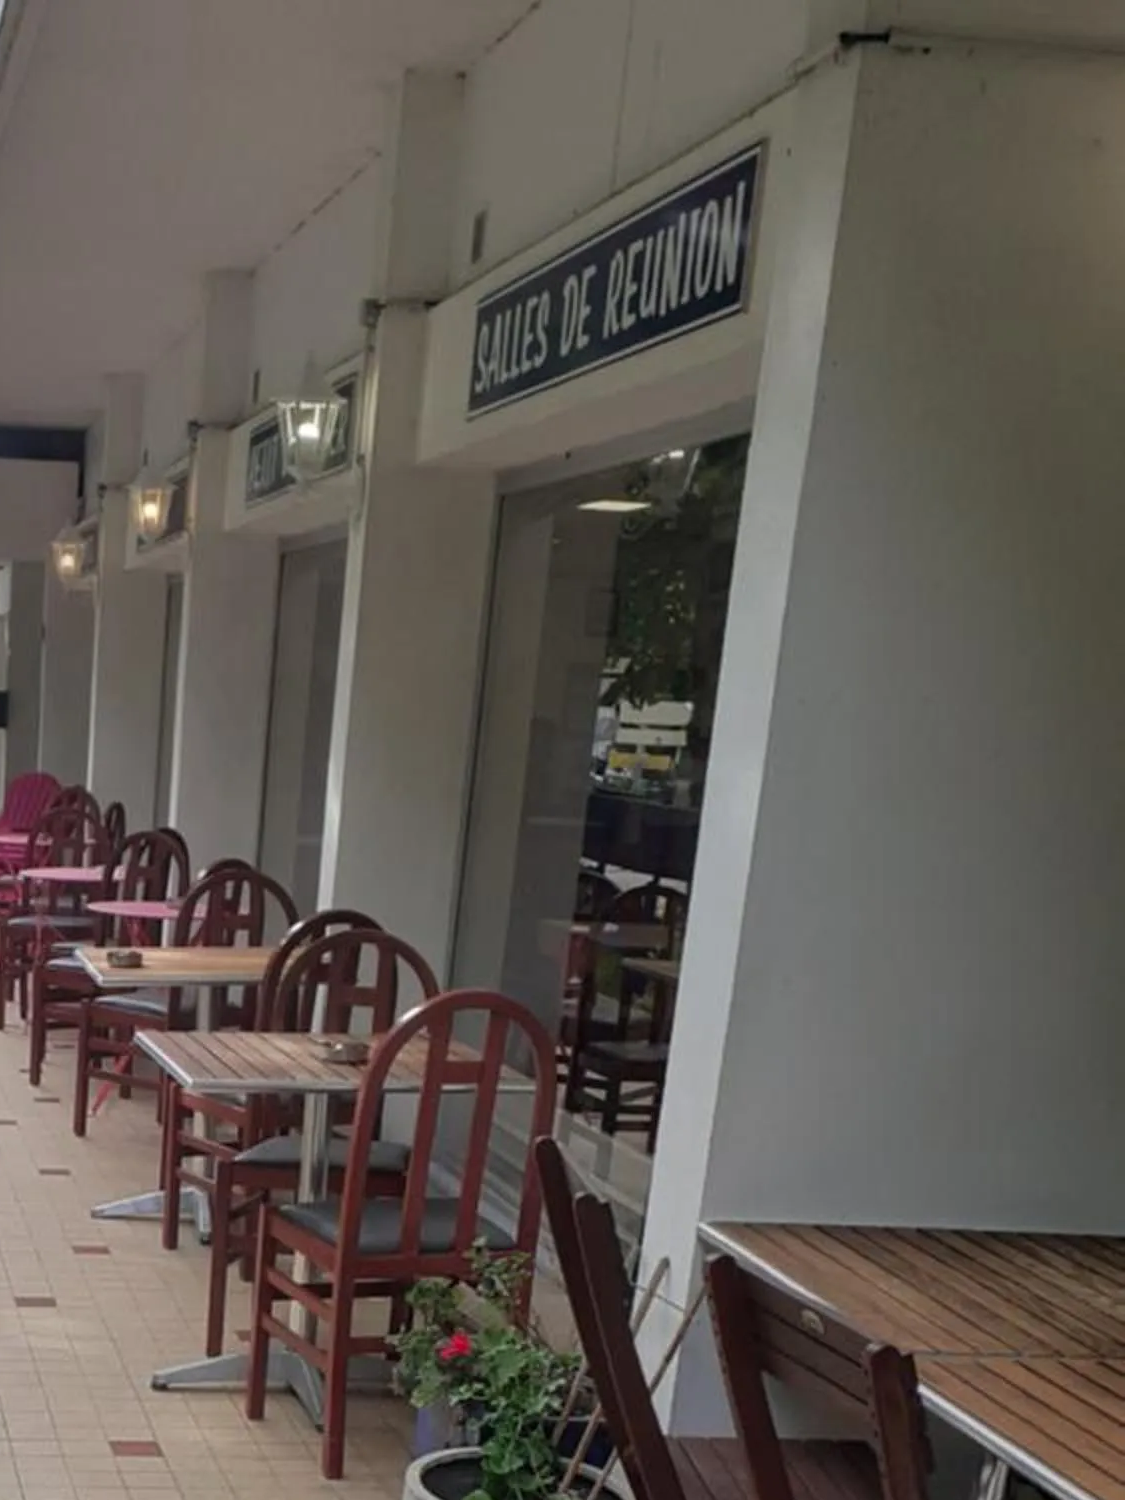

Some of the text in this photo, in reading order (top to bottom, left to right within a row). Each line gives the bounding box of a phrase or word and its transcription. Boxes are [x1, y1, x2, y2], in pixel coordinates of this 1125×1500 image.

[475, 181, 746, 392] SALLES DE REUNION
